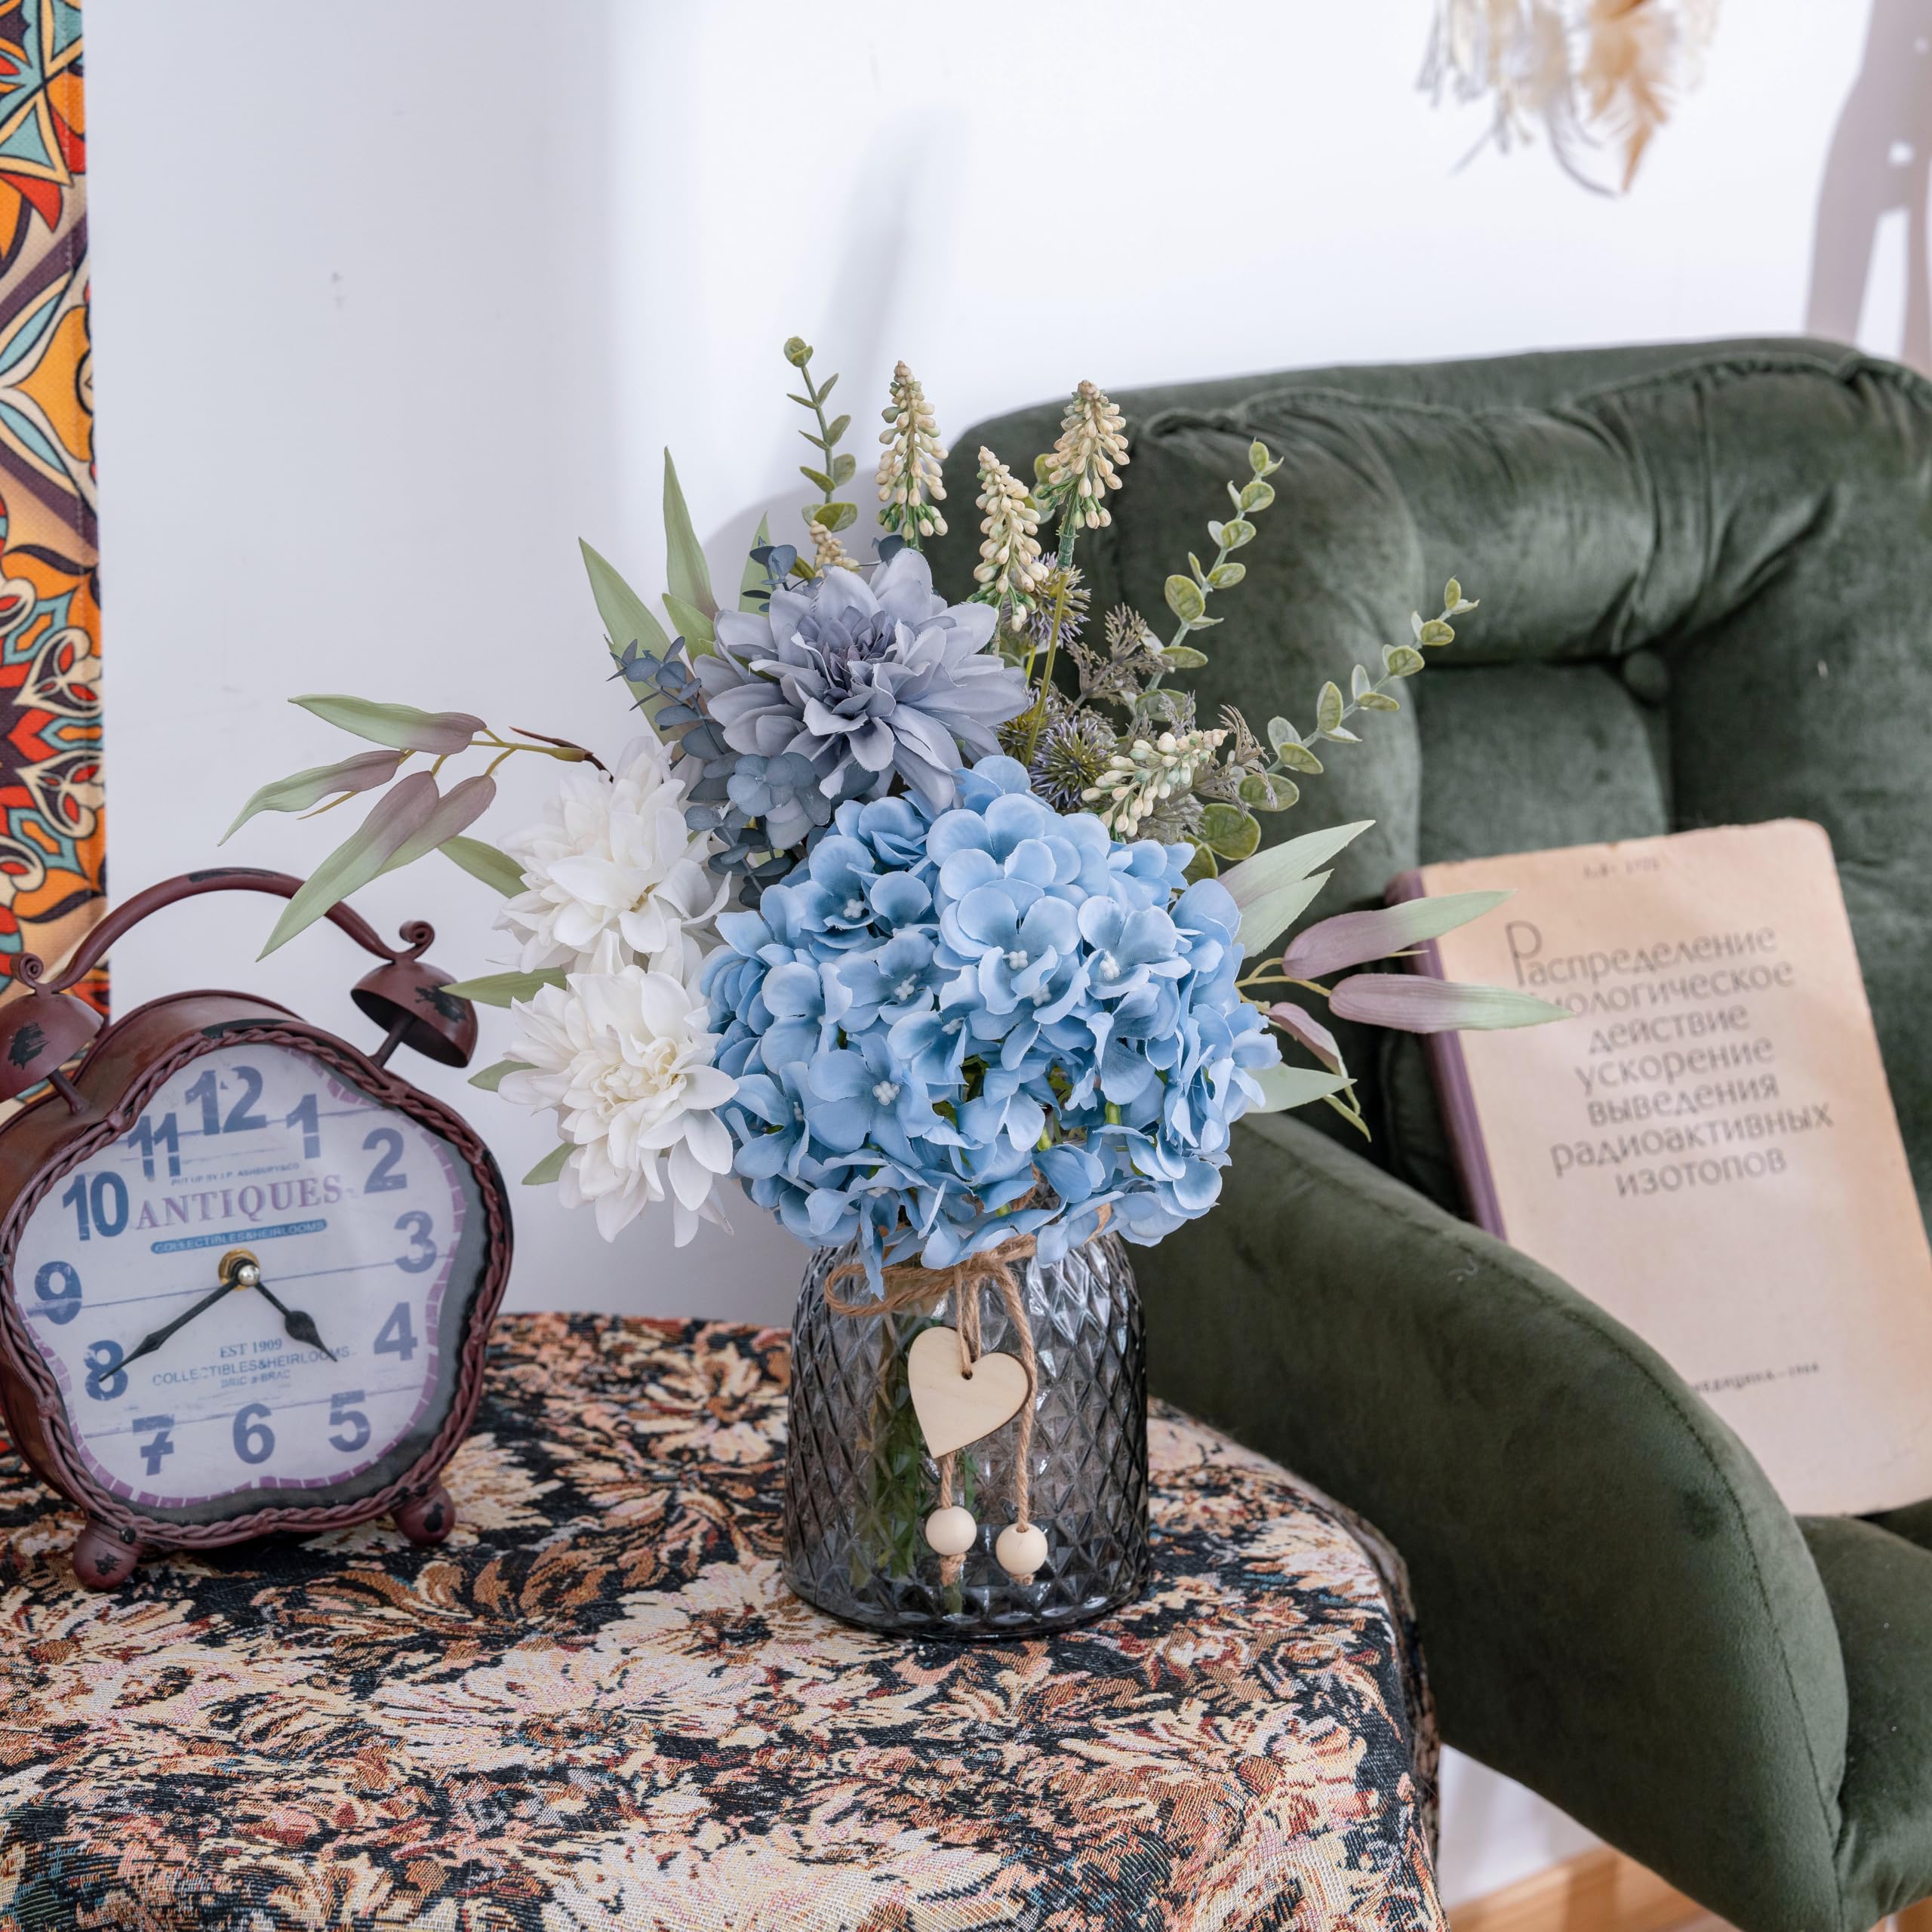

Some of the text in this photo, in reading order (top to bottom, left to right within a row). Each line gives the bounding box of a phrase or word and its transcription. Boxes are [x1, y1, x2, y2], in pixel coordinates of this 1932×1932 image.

[1505, 920, 1779, 988] Распределение
[1549, 959, 1795, 1018] ологическое
[1587, 1004, 1751, 1056] действие
[1574, 1036, 1775, 1097] ускорение
[184, 1065, 267, 1136] 12
[285, 1094, 321, 1160] 1
[1587, 1072, 1780, 1128] выведения
[127, 1112, 182, 1180] 11
[361, 1127, 408, 1195] 2
[1549, 1103, 1835, 1180] радиоактивных
[1616, 1147, 1788, 1199] изотопов
[61, 1171, 130, 1241] 10
[134, 1174, 343, 1231] ANTIQUES
[393, 1210, 438, 1274] 3
[34, 1260, 82, 1325] 9
[220, 1338, 283, 1358] EST 1909
[372, 1301, 419, 1362] 4
[84, 1340, 129, 1401] 8
[131, 1413, 176, 1476] 7
[232, 1402, 276, 1465] 6
[328, 1389, 371, 1453] 5
